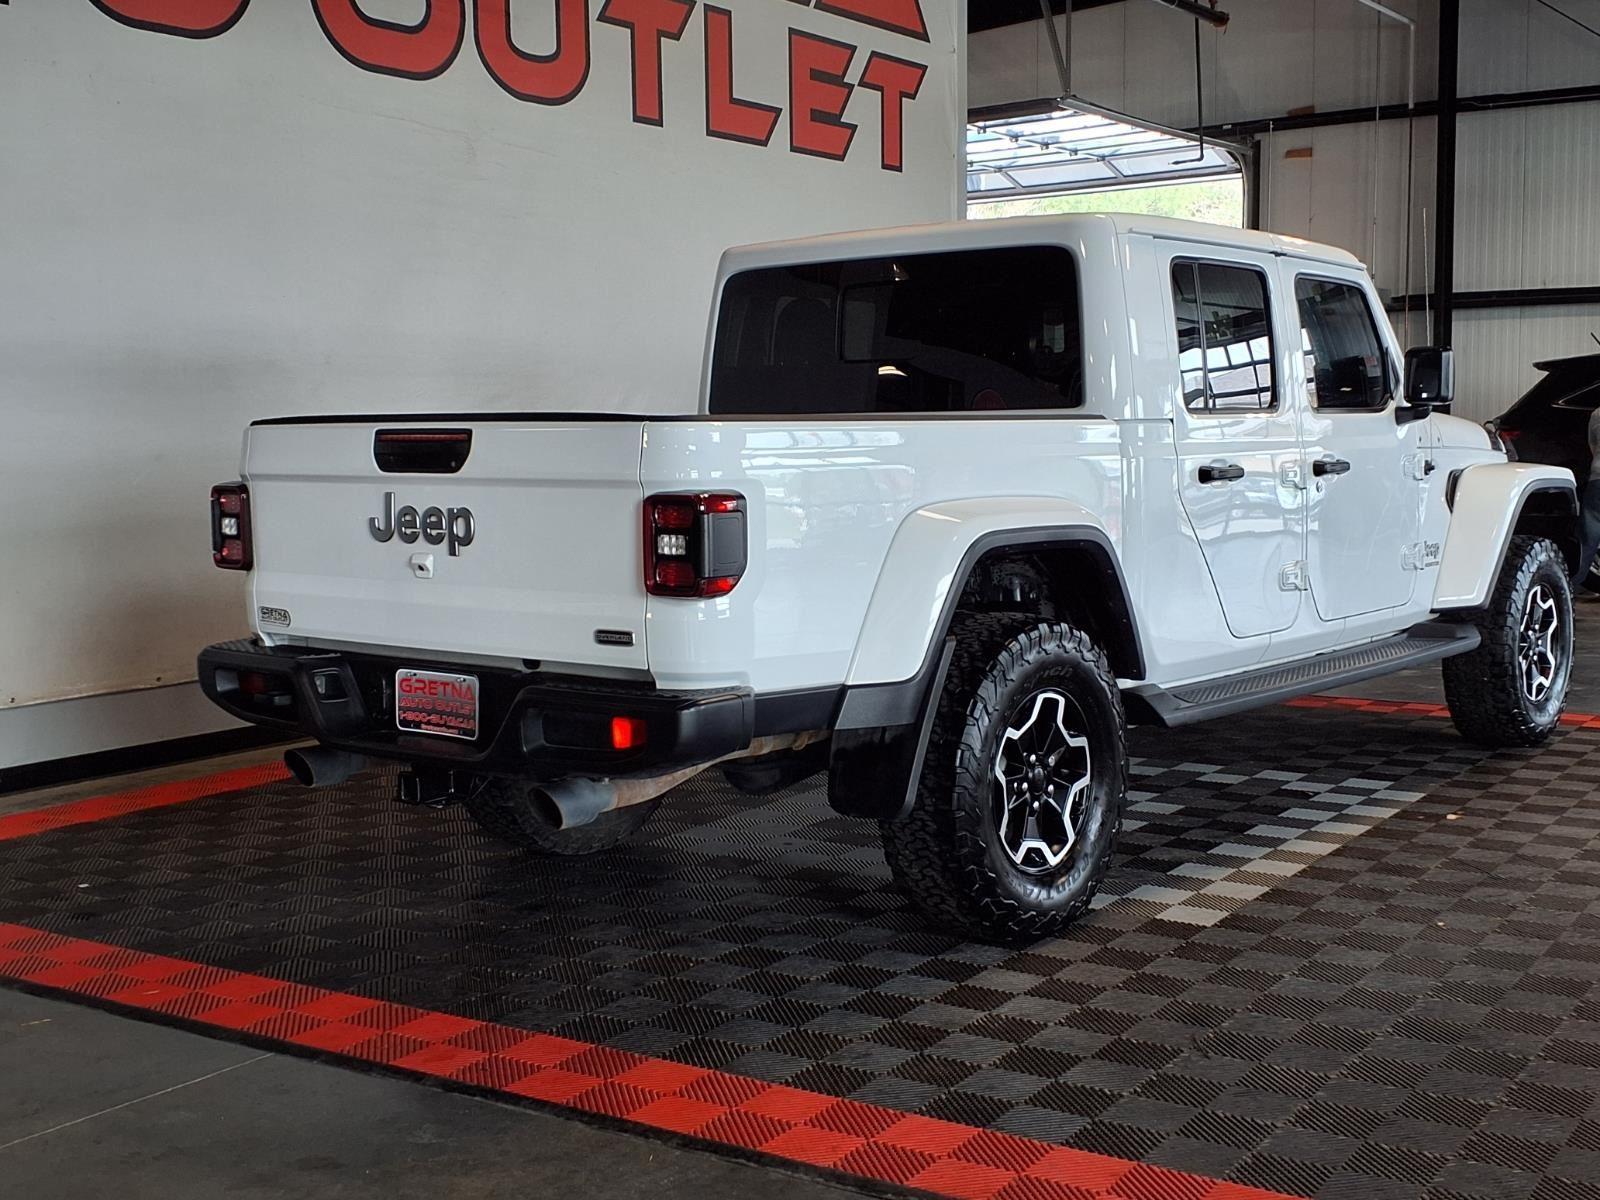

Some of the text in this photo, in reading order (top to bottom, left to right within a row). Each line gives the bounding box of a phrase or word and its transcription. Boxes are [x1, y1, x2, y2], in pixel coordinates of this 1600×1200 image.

[369, 491, 476, 557] Jeep
[400, 678, 474, 700] GRETNA
[400, 697, 475, 715] AUTO OUTLET
